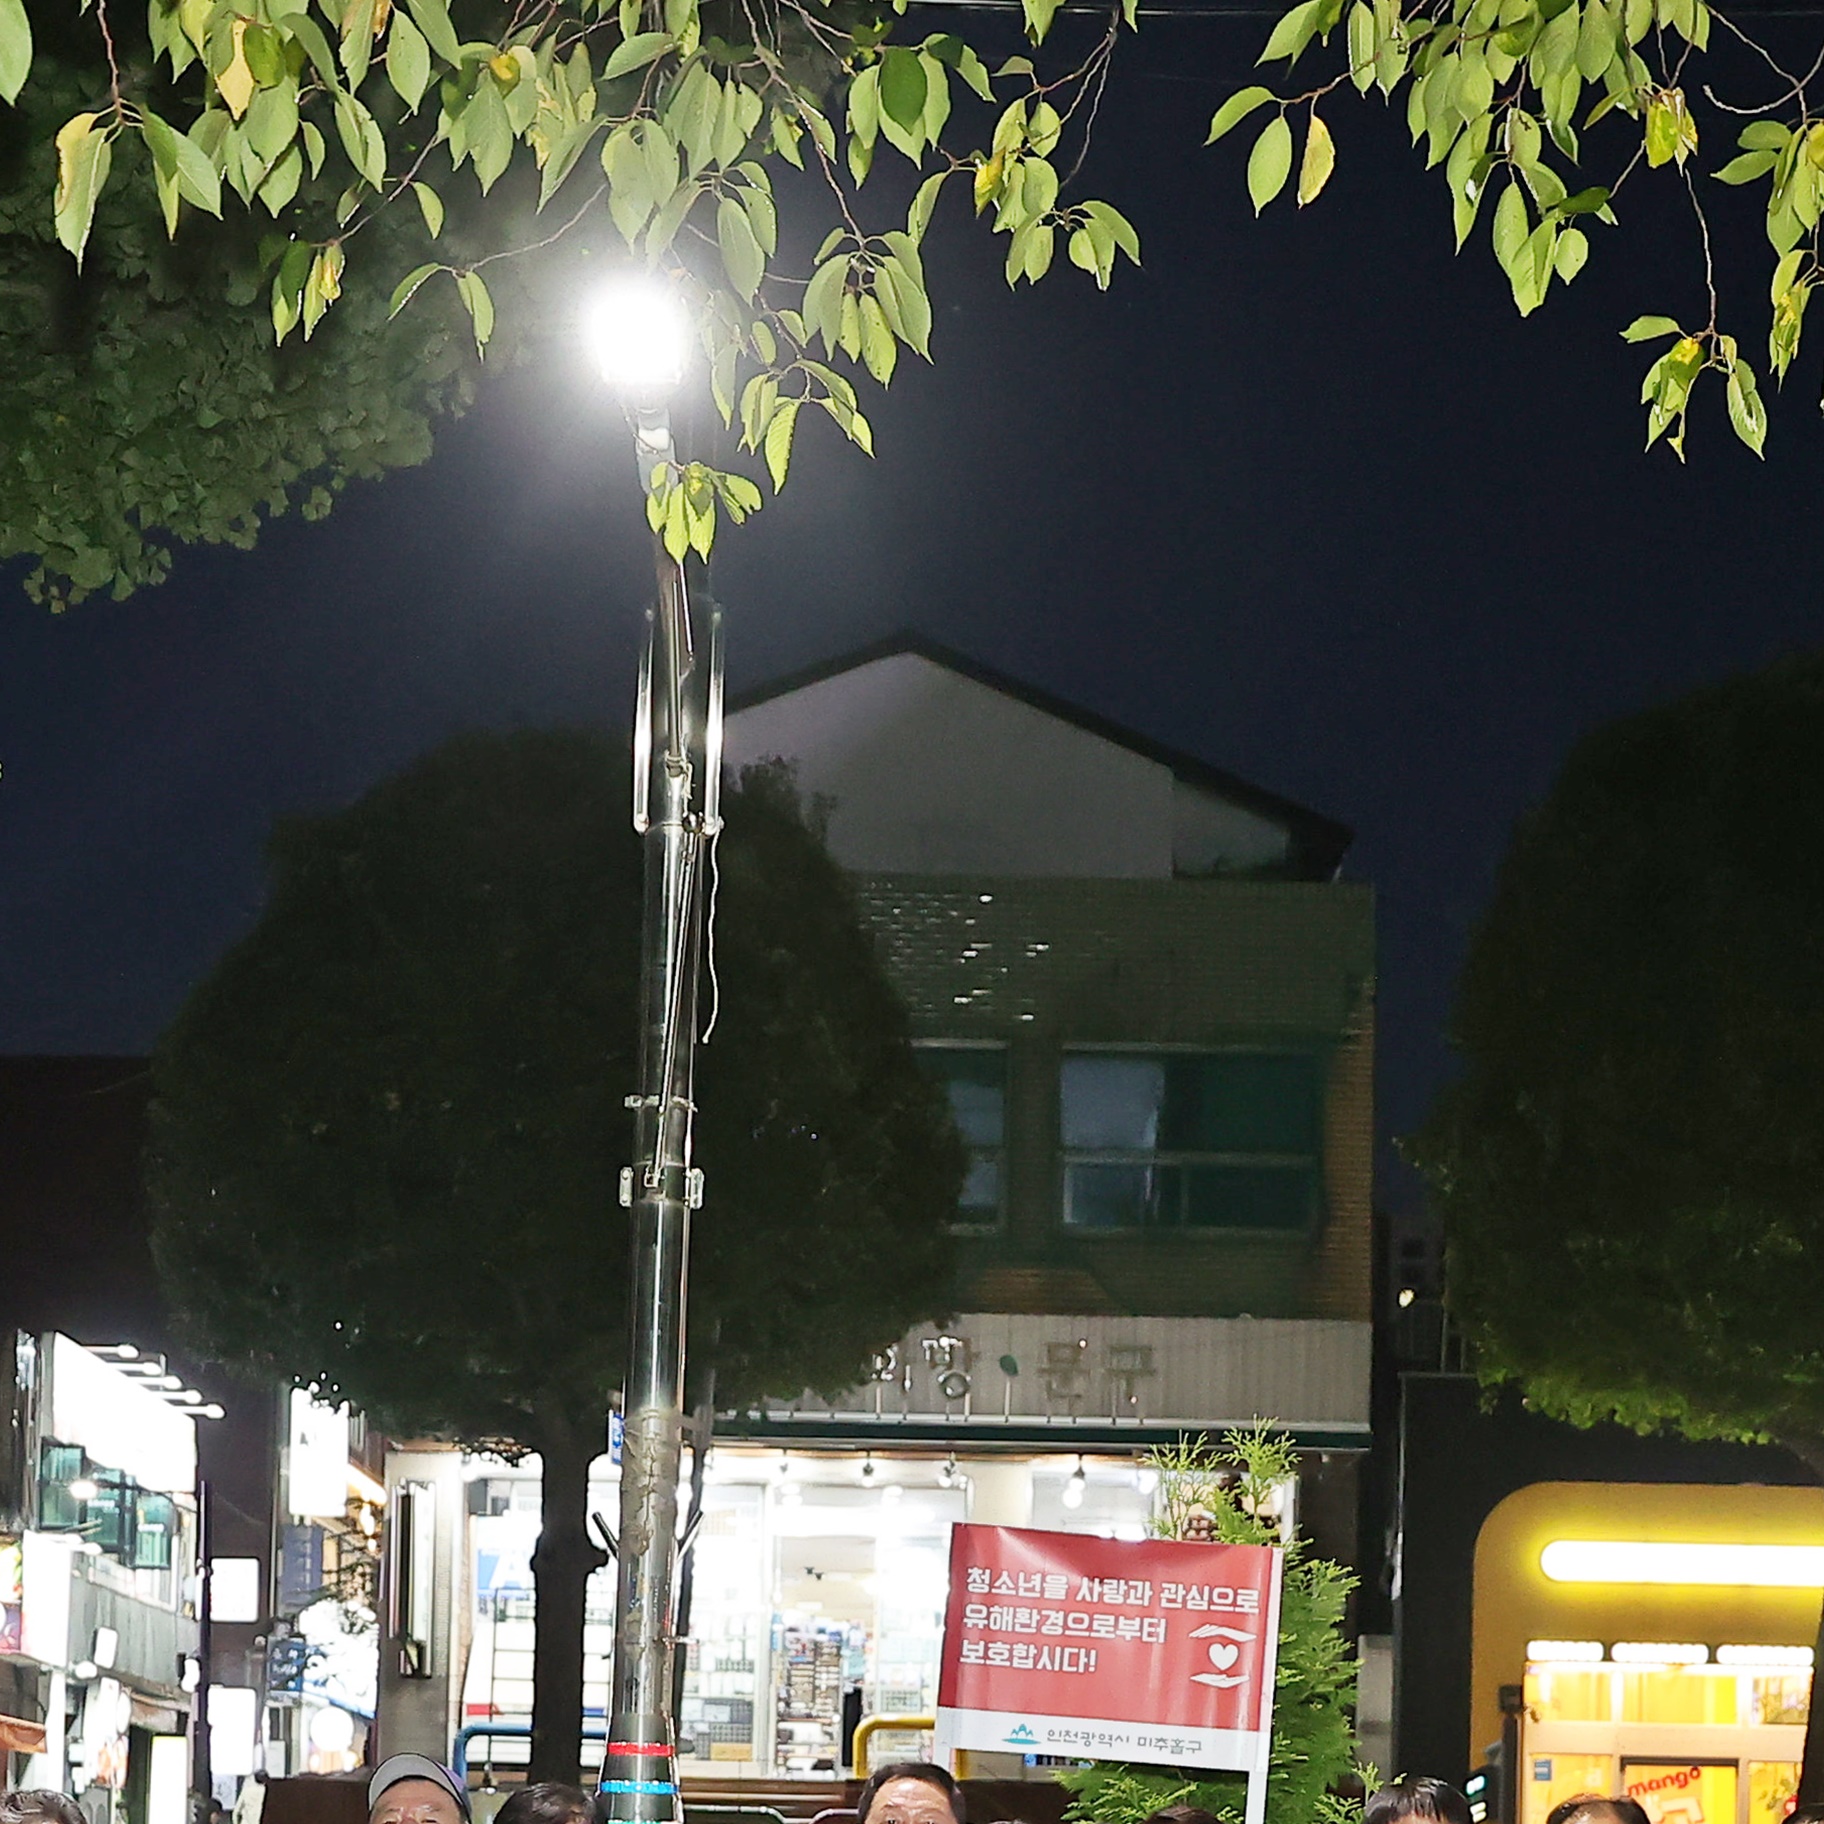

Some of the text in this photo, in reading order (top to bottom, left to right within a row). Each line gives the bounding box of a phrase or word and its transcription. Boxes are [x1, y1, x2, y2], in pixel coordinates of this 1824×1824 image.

[966, 1566, 1260, 1615] 청소년을 사랑과 관심으로
[962, 1604, 1167, 1644] 유해환경으로부터
[959, 1639, 1097, 1673] 보호합시다!
[1046, 1728, 1202, 1756] 인천광역시 미추홀구
[1627, 1765, 1703, 1797] mango
